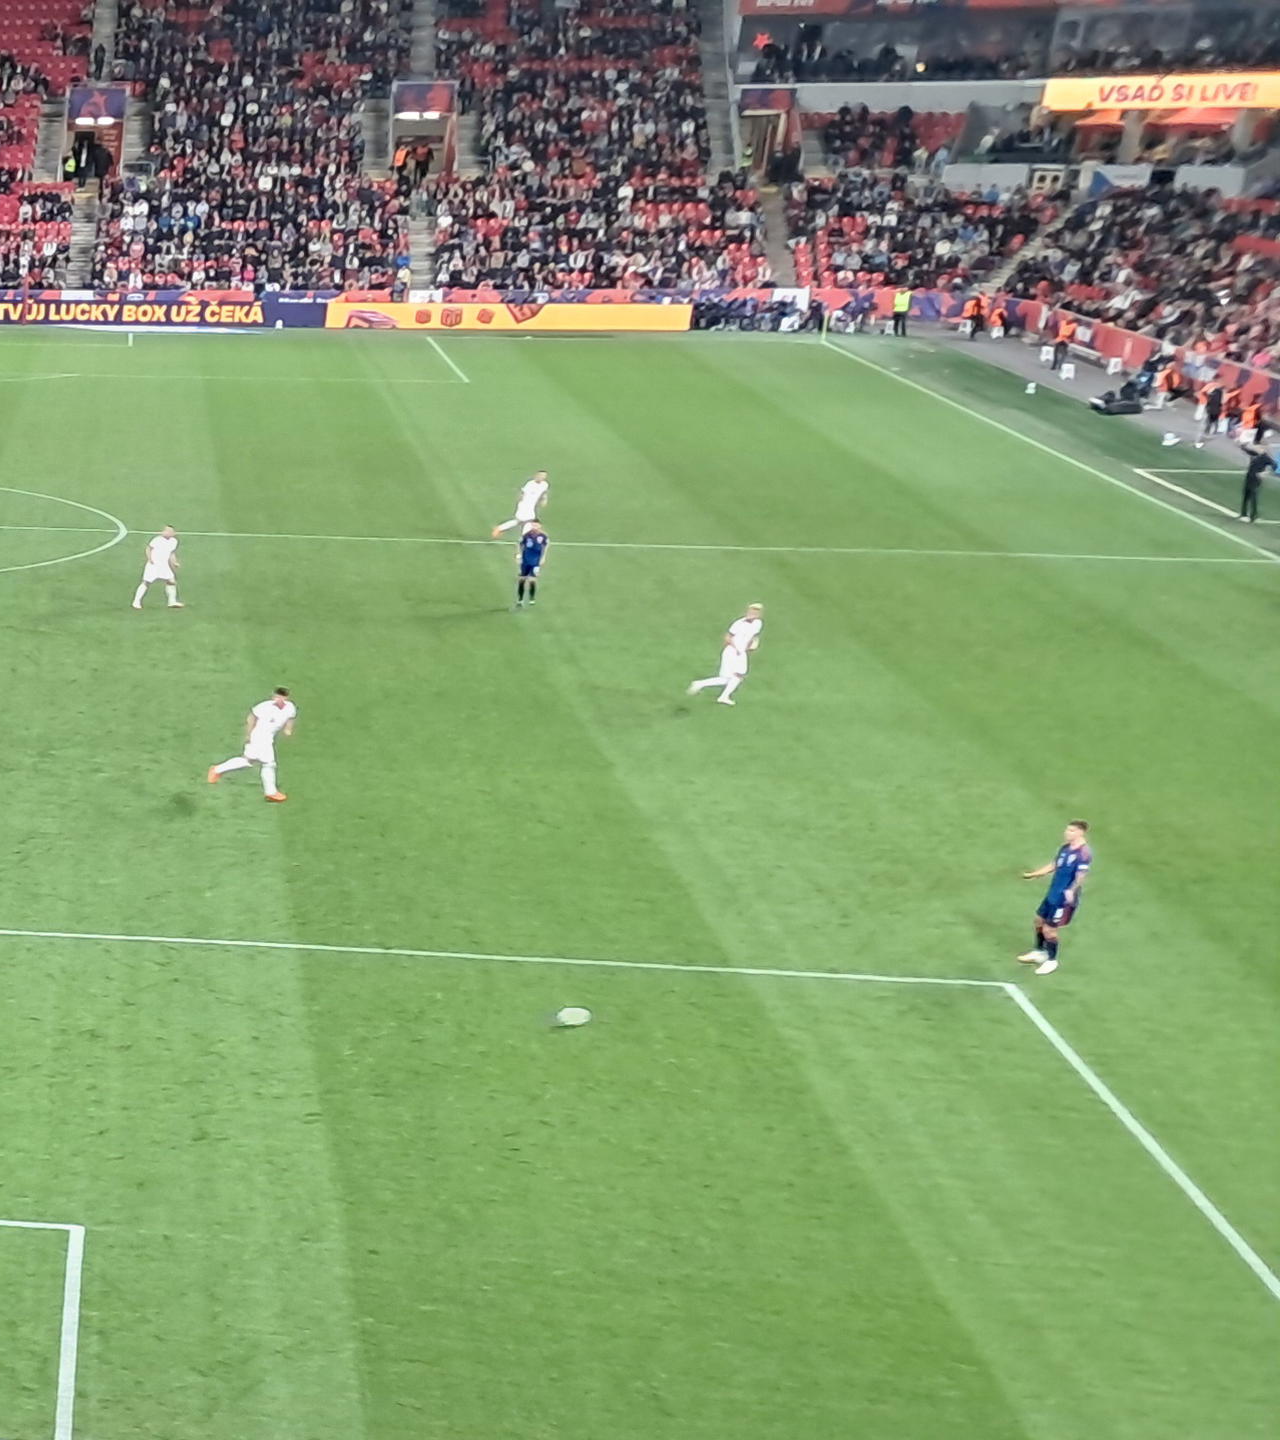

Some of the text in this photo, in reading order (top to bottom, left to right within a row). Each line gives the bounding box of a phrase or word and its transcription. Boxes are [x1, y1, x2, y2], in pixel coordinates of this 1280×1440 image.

[1170, 83, 1195, 101] SI
[48, 303, 120, 322] LUCKY
[122, 304, 169, 323] BOX
[204, 300, 265, 324] ČEKÁ
